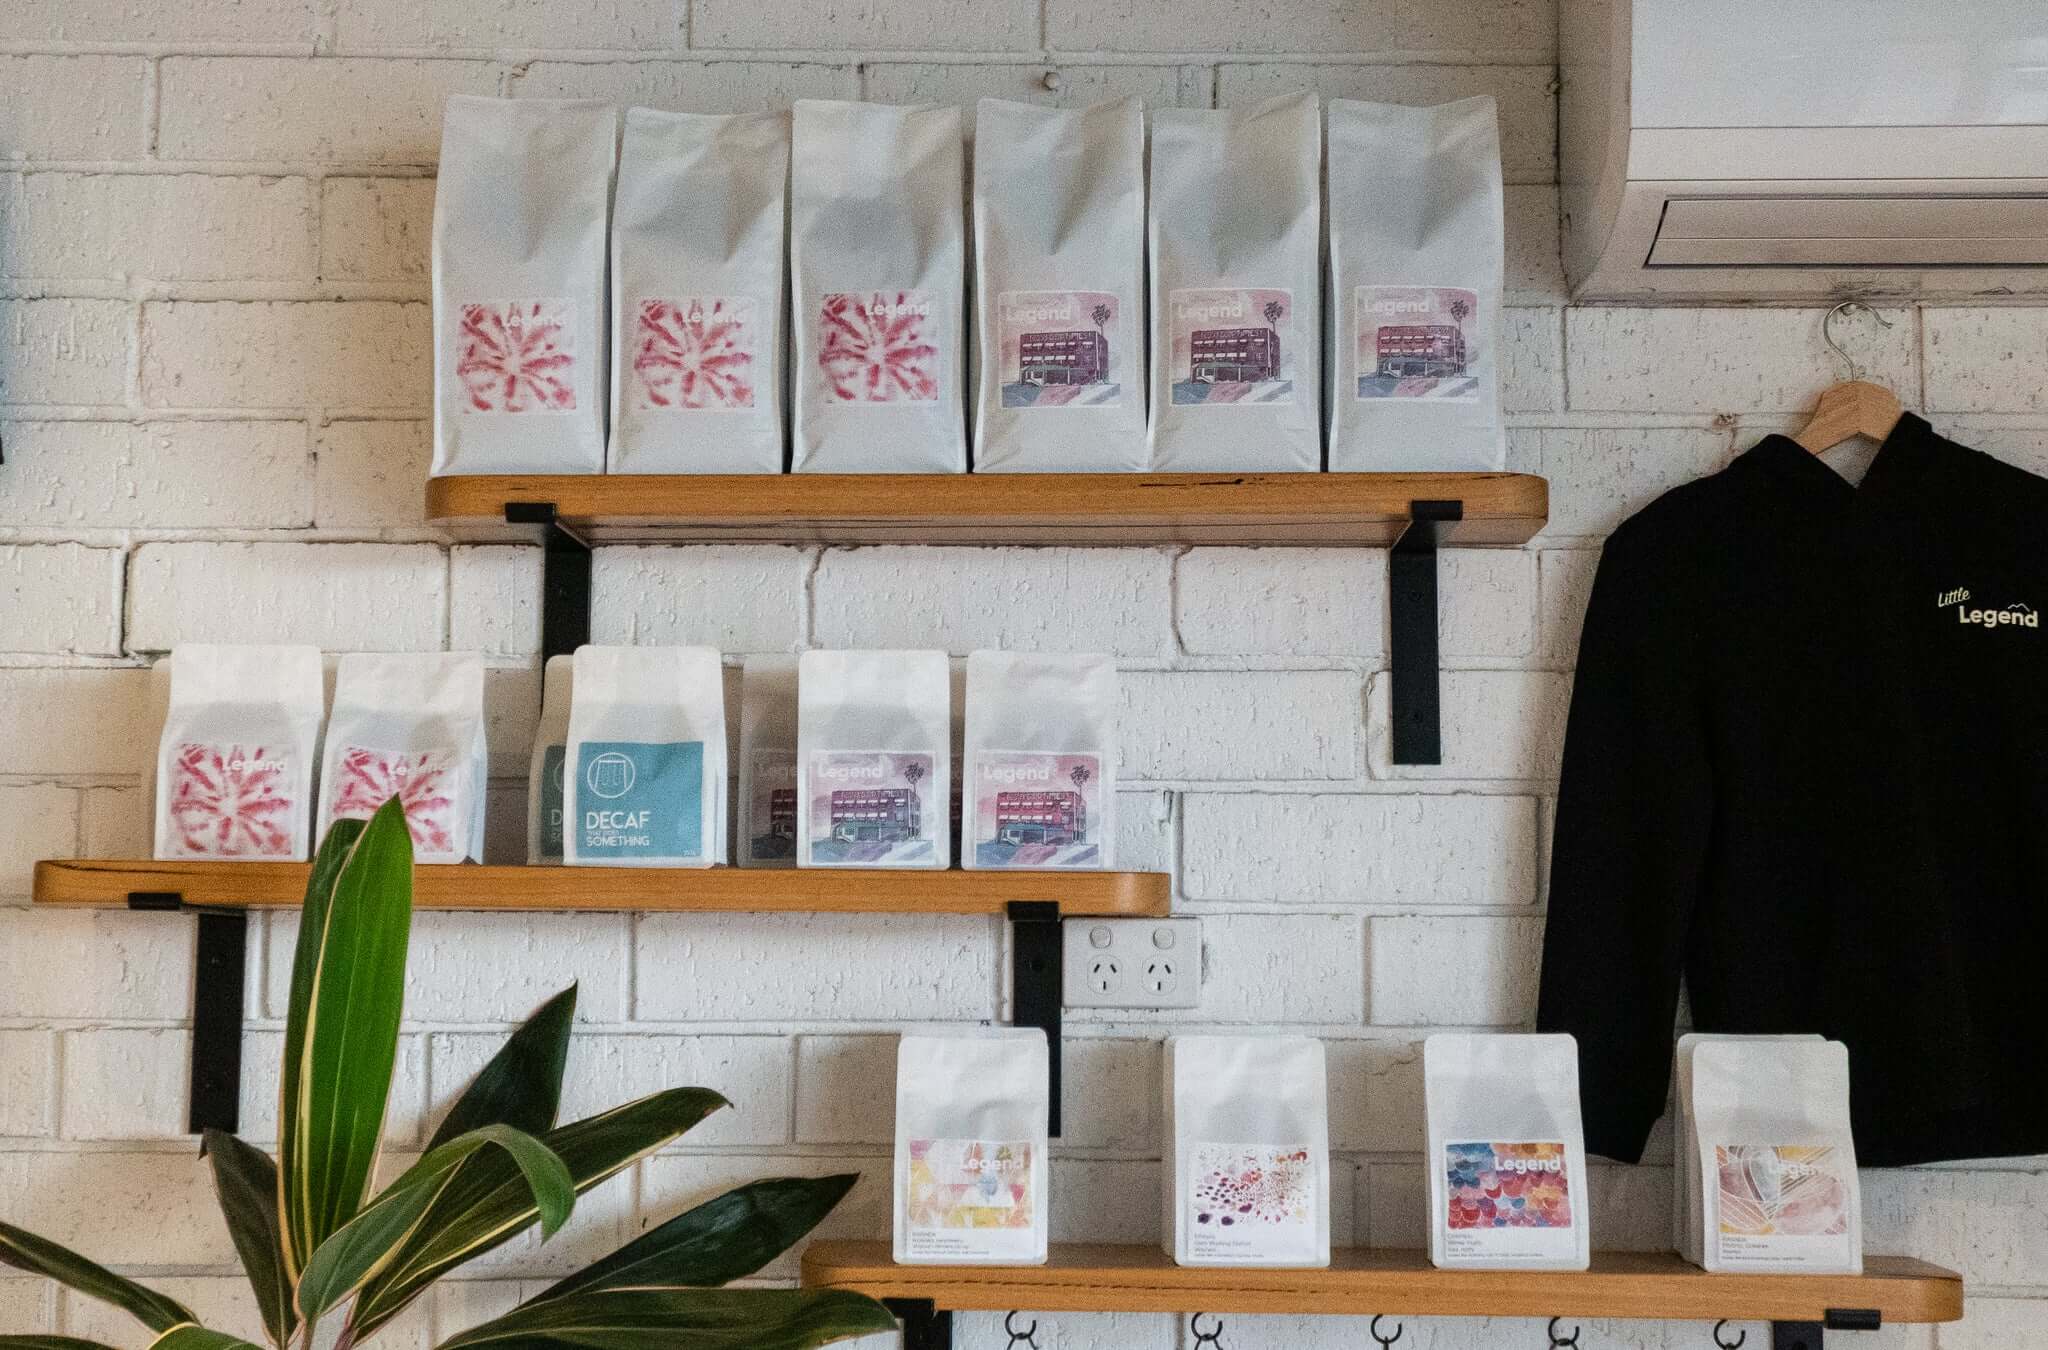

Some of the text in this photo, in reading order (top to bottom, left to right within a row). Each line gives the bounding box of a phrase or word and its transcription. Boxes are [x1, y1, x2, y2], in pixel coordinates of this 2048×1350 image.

[864, 302, 929, 320] Legend
[1007, 304, 1072, 323] Legend
[1178, 302, 1242, 322] Legend
[1364, 297, 1430, 316] Legend
[1938, 587, 1970, 607] Little
[1959, 605, 2039, 628] Legend
[818, 763, 882, 781] Legend
[984, 764, 1049, 783] Legend
[586, 811, 651, 829] DECAF
[586, 836, 650, 847] SOMETHING
[1495, 1154, 1561, 1174] Legend
